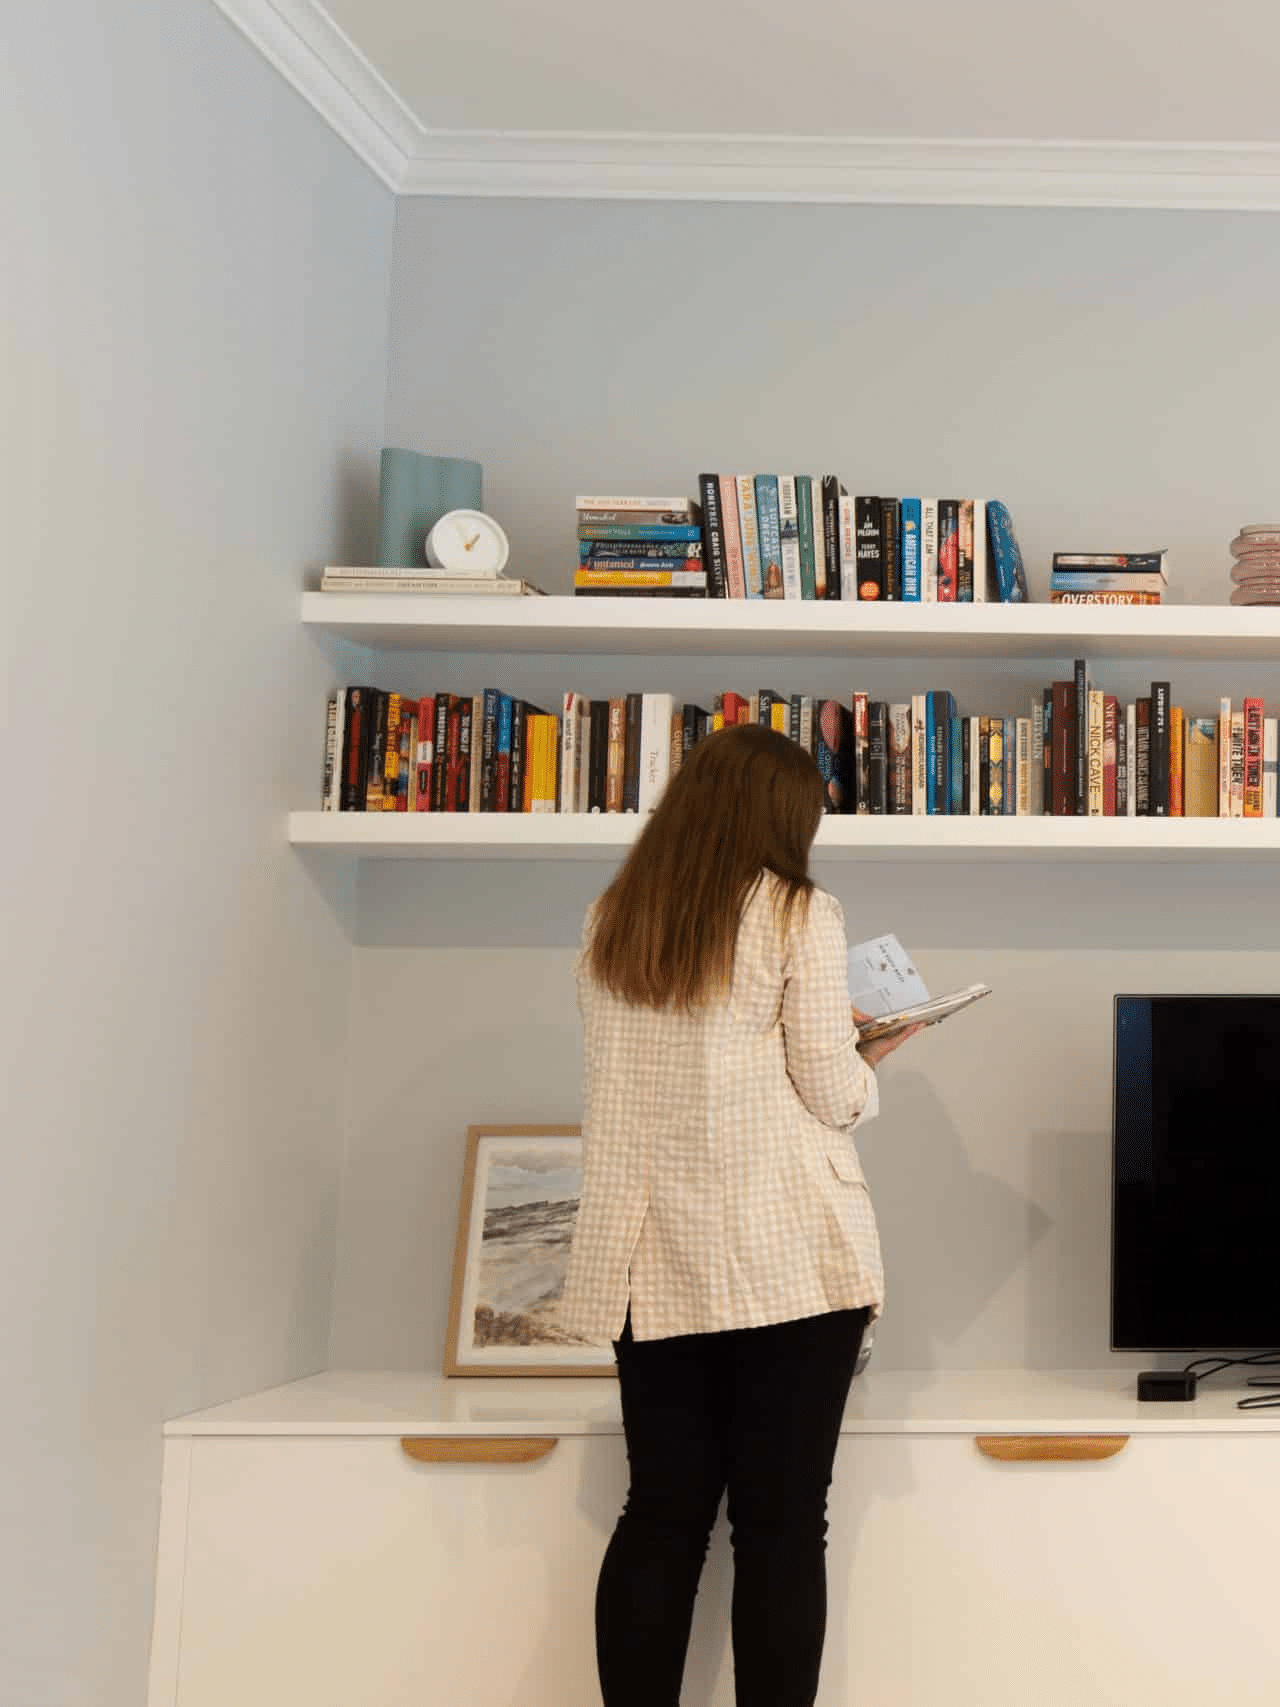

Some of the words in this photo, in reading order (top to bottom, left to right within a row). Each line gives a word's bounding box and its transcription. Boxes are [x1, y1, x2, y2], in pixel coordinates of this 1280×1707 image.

[705, 482, 718, 529] HONEYBEE
[710, 530, 720, 556] CRAIG
[904, 534, 917, 577] AMERICAN
[1062, 594, 1134, 605] OVERSTORY
[1156, 688, 1165, 706] LIFE
[1105, 702, 1116, 728] NICK
[1090, 725, 1101, 757] NICK
[1090, 758, 1101, 794] CAVE
[1230, 758, 1245, 786] TIGER
[1246, 760, 1261, 788] TOWER
